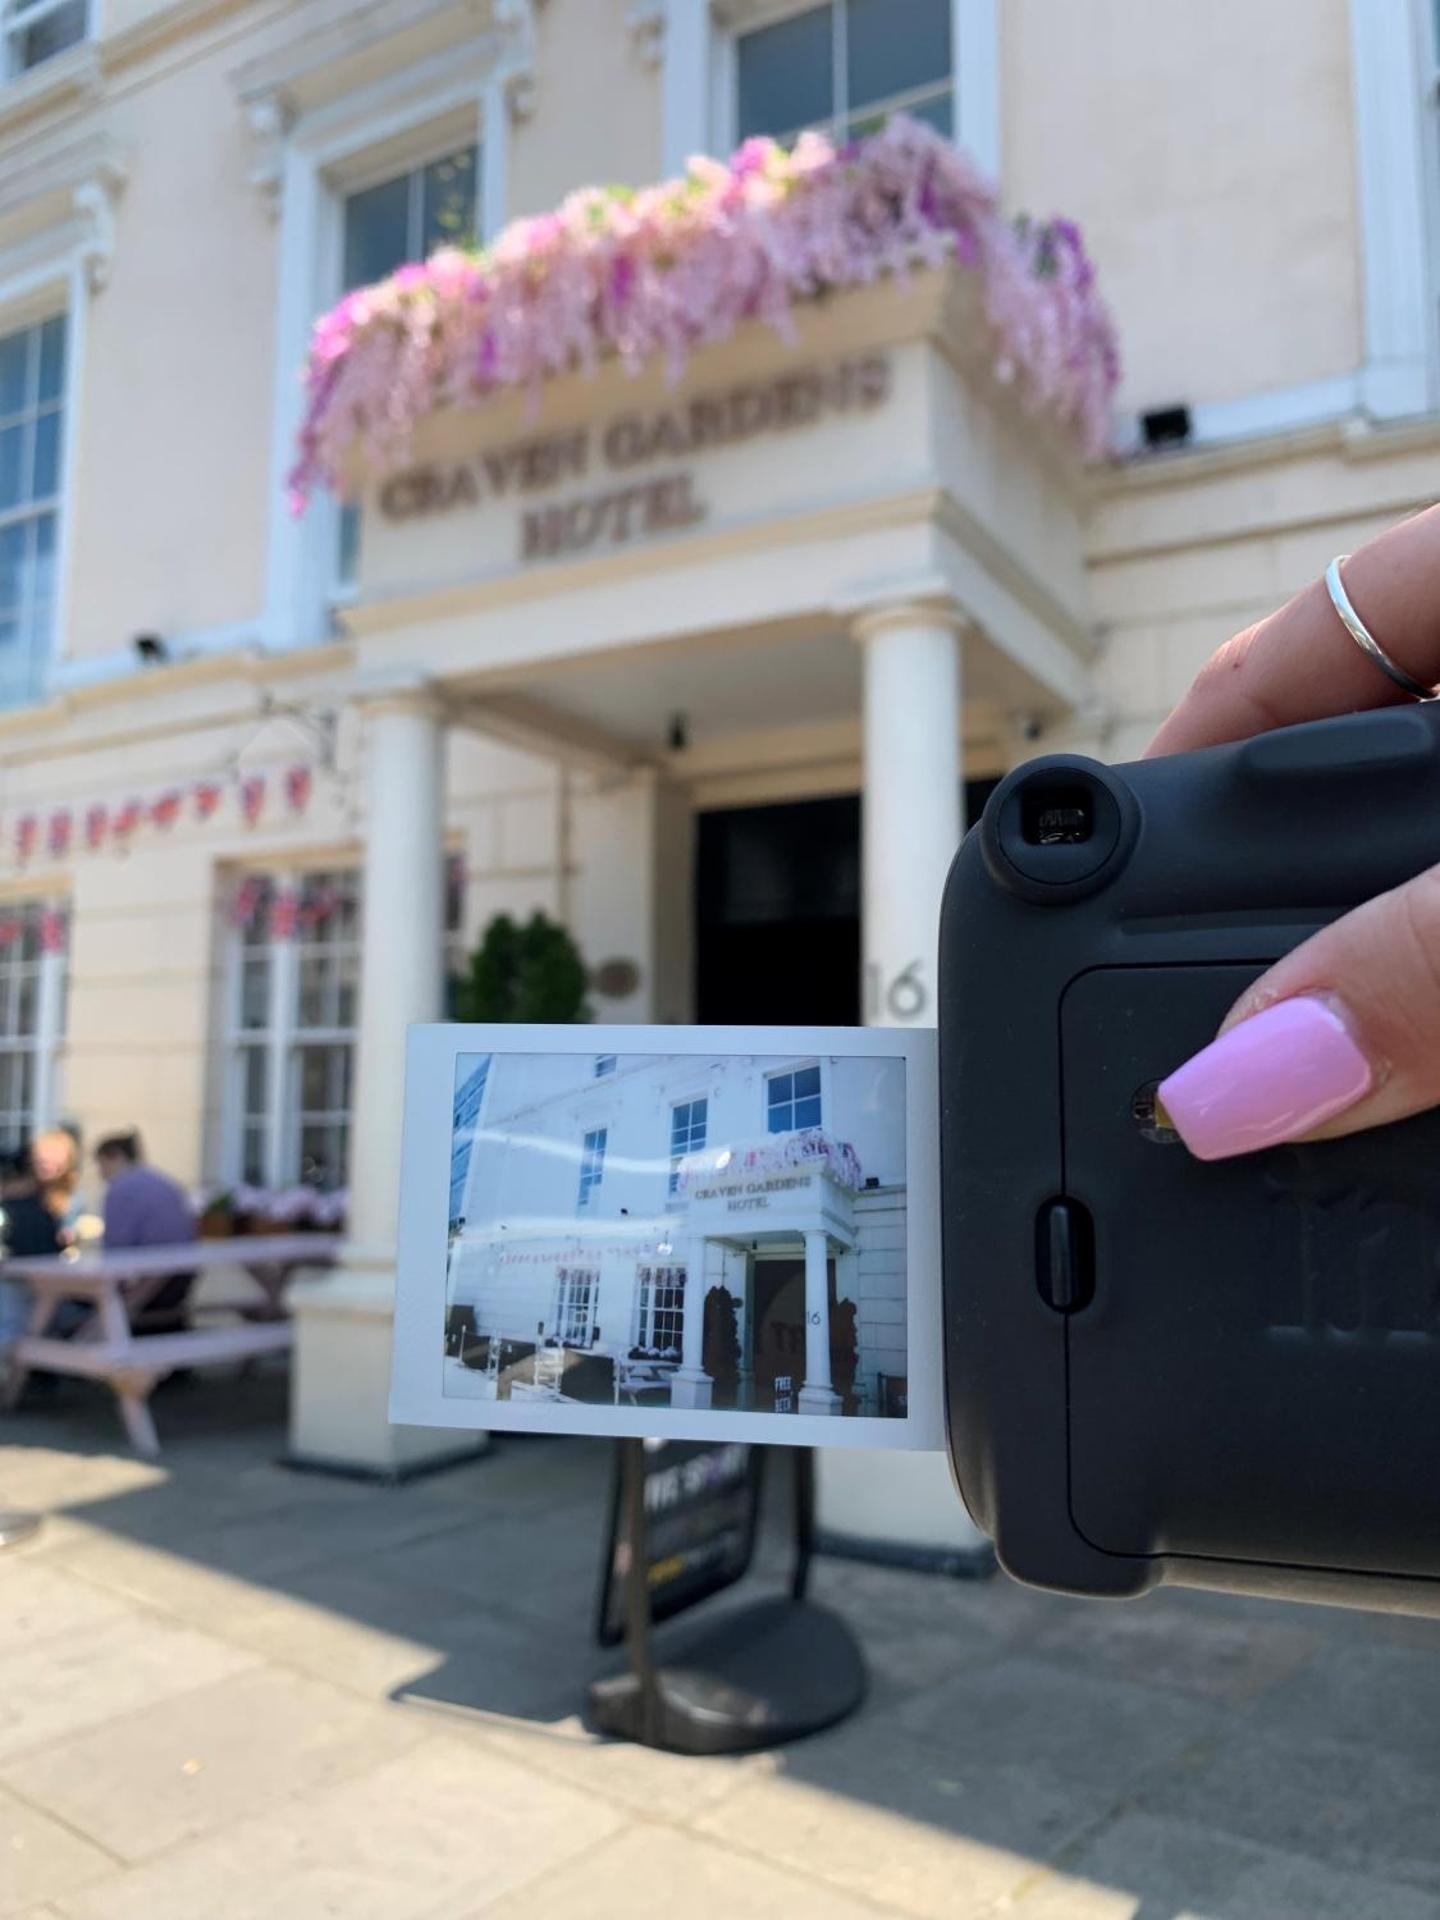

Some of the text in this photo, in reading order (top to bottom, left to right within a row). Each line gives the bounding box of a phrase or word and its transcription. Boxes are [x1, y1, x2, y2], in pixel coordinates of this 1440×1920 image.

[381, 356, 891, 521] CRAVEN GARDENS
[519, 474, 706, 560] HOTEL
[864, 957, 926, 1022] 16
[695, 1176, 811, 1199] CRAVEN GARDENS
[727, 1197, 769, 1211] HOTEL
[807, 1311, 820, 1325] 16
